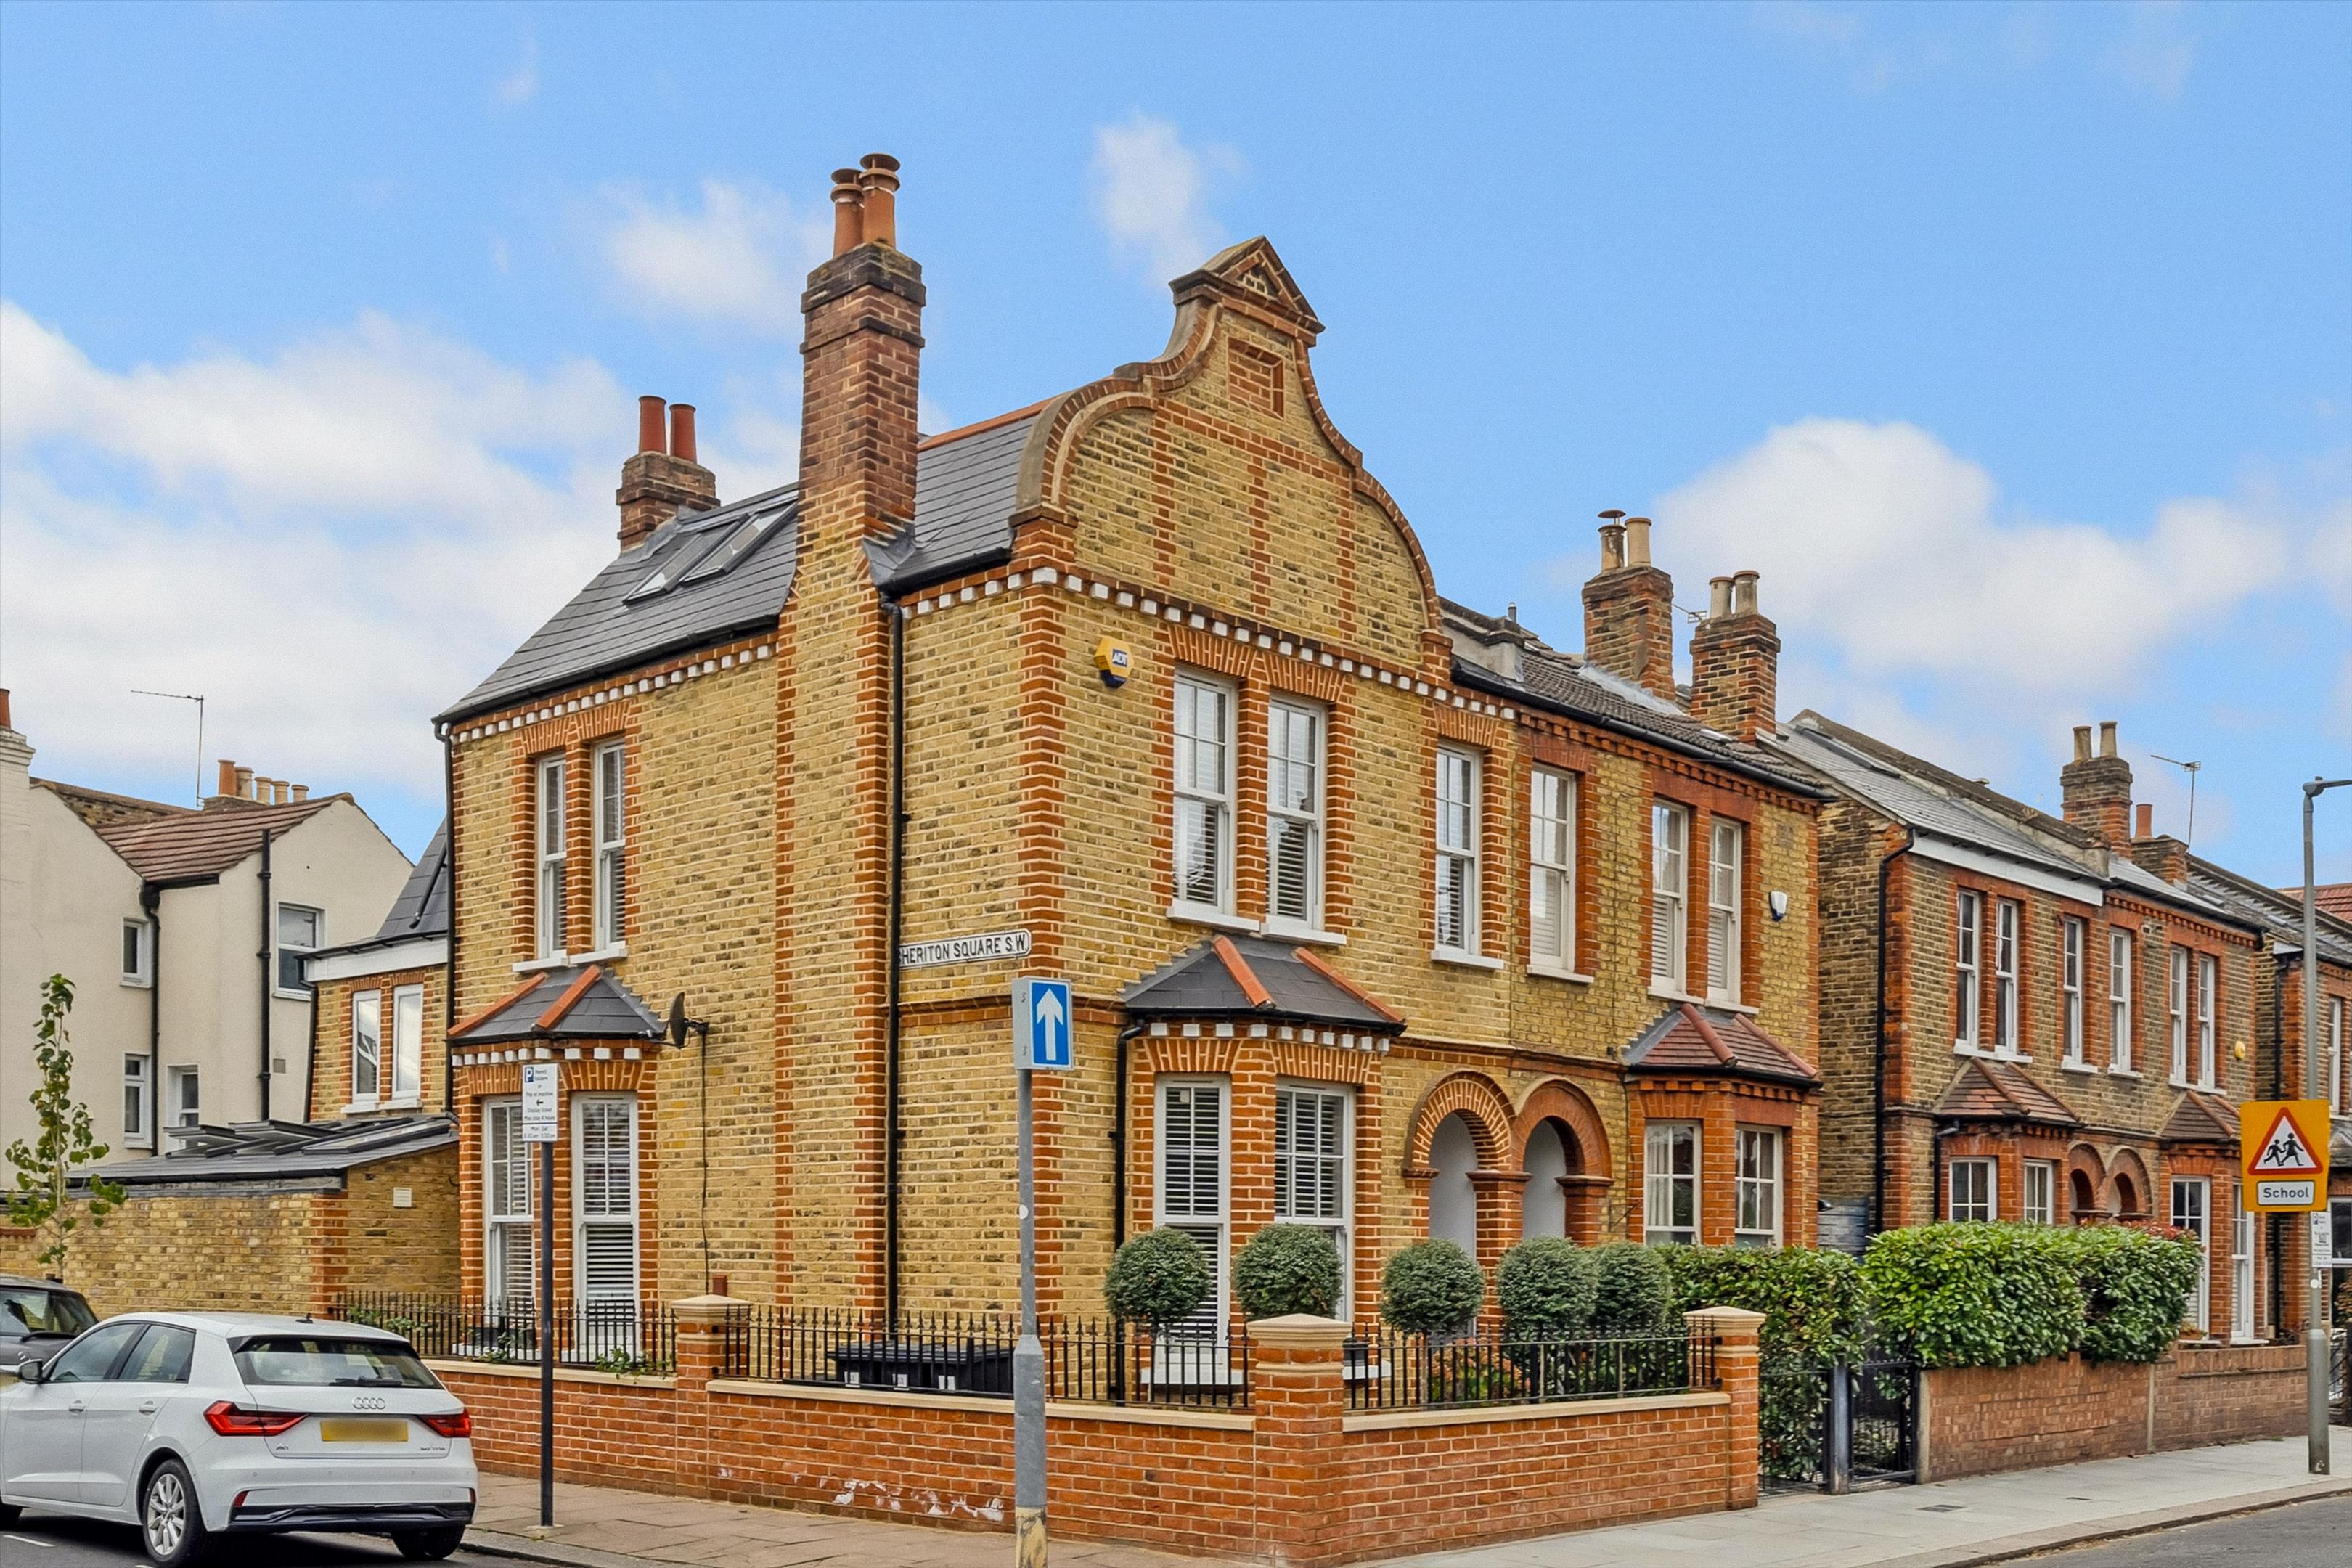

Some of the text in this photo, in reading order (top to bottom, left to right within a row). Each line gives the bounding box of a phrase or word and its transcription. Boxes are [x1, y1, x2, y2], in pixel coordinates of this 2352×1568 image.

[899, 944, 950, 964] HERITON
[953, 936, 1001, 957] SQUARE
[2263, 1187, 2309, 1198] School
